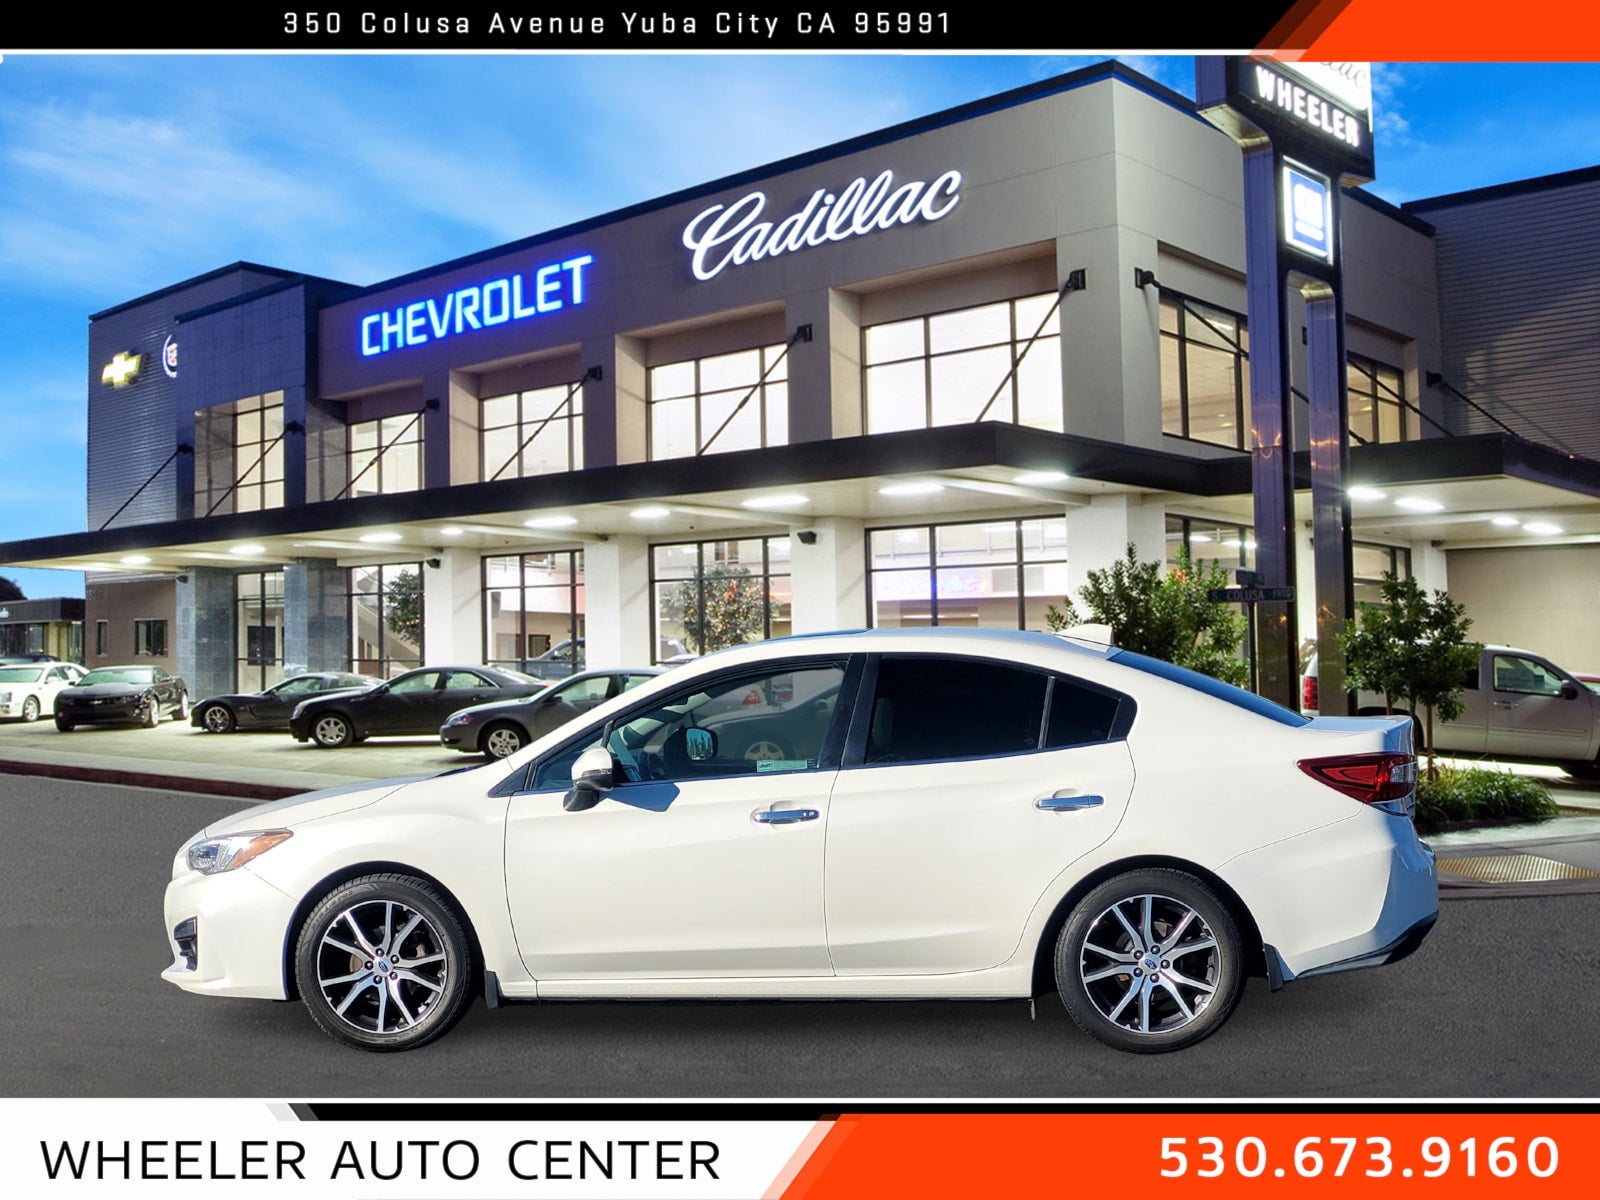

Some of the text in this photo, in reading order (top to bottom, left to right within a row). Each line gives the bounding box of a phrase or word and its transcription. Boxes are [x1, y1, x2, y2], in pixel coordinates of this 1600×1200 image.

[1255, 65, 1359, 147] WHEELER
[681, 168, 963, 282] Cadillac
[361, 254, 594, 358] CHEVROLET
[1226, 589, 1265, 601] COLUSA
